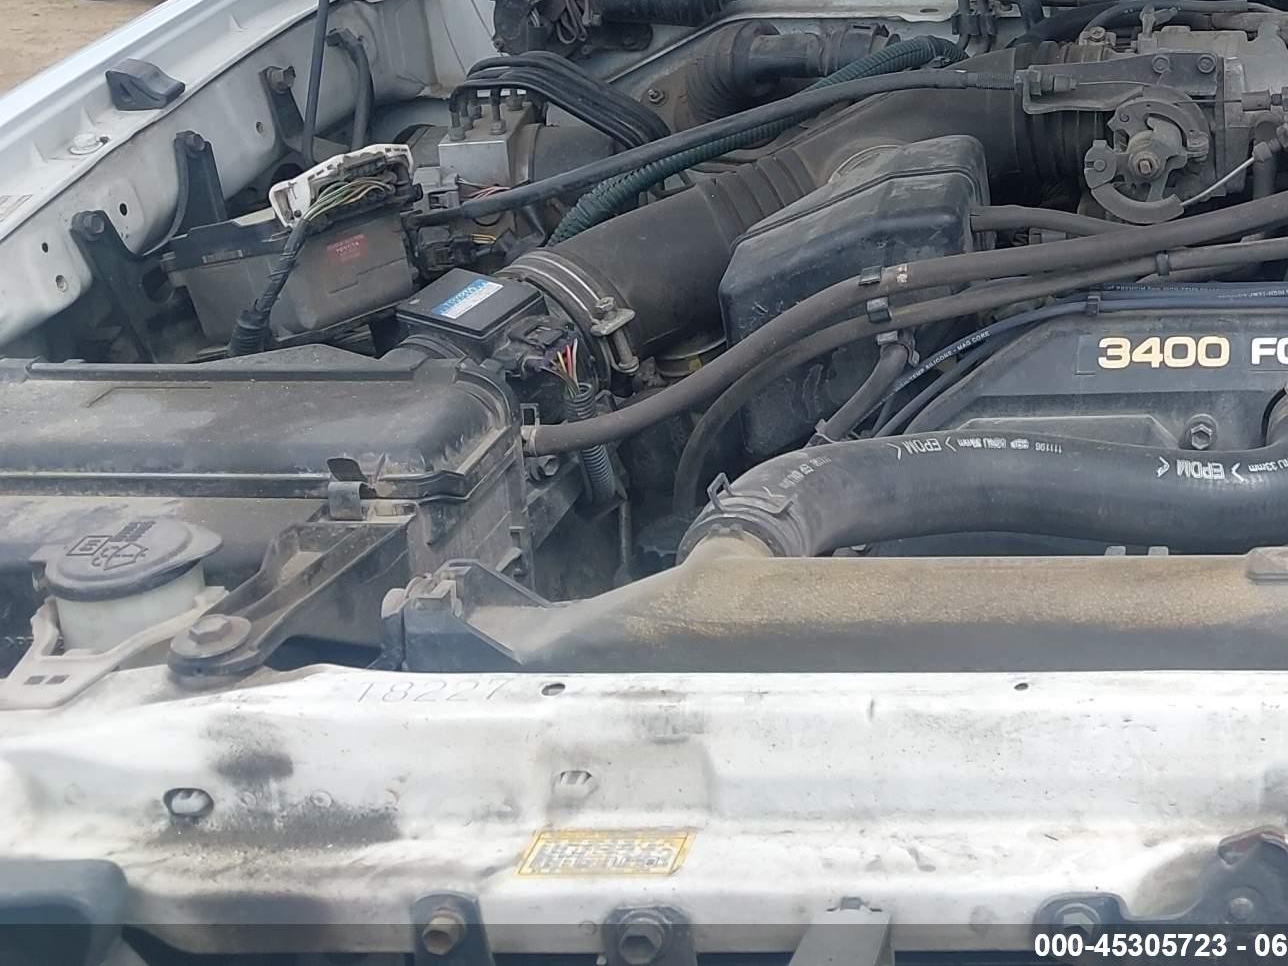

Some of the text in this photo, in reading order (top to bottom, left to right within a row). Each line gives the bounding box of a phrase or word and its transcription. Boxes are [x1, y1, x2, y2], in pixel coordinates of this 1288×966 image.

[1097, 335, 1230, 369] 3400
[902, 438, 943, 455] EPDM
[1176, 459, 1226, 480] EPDM
